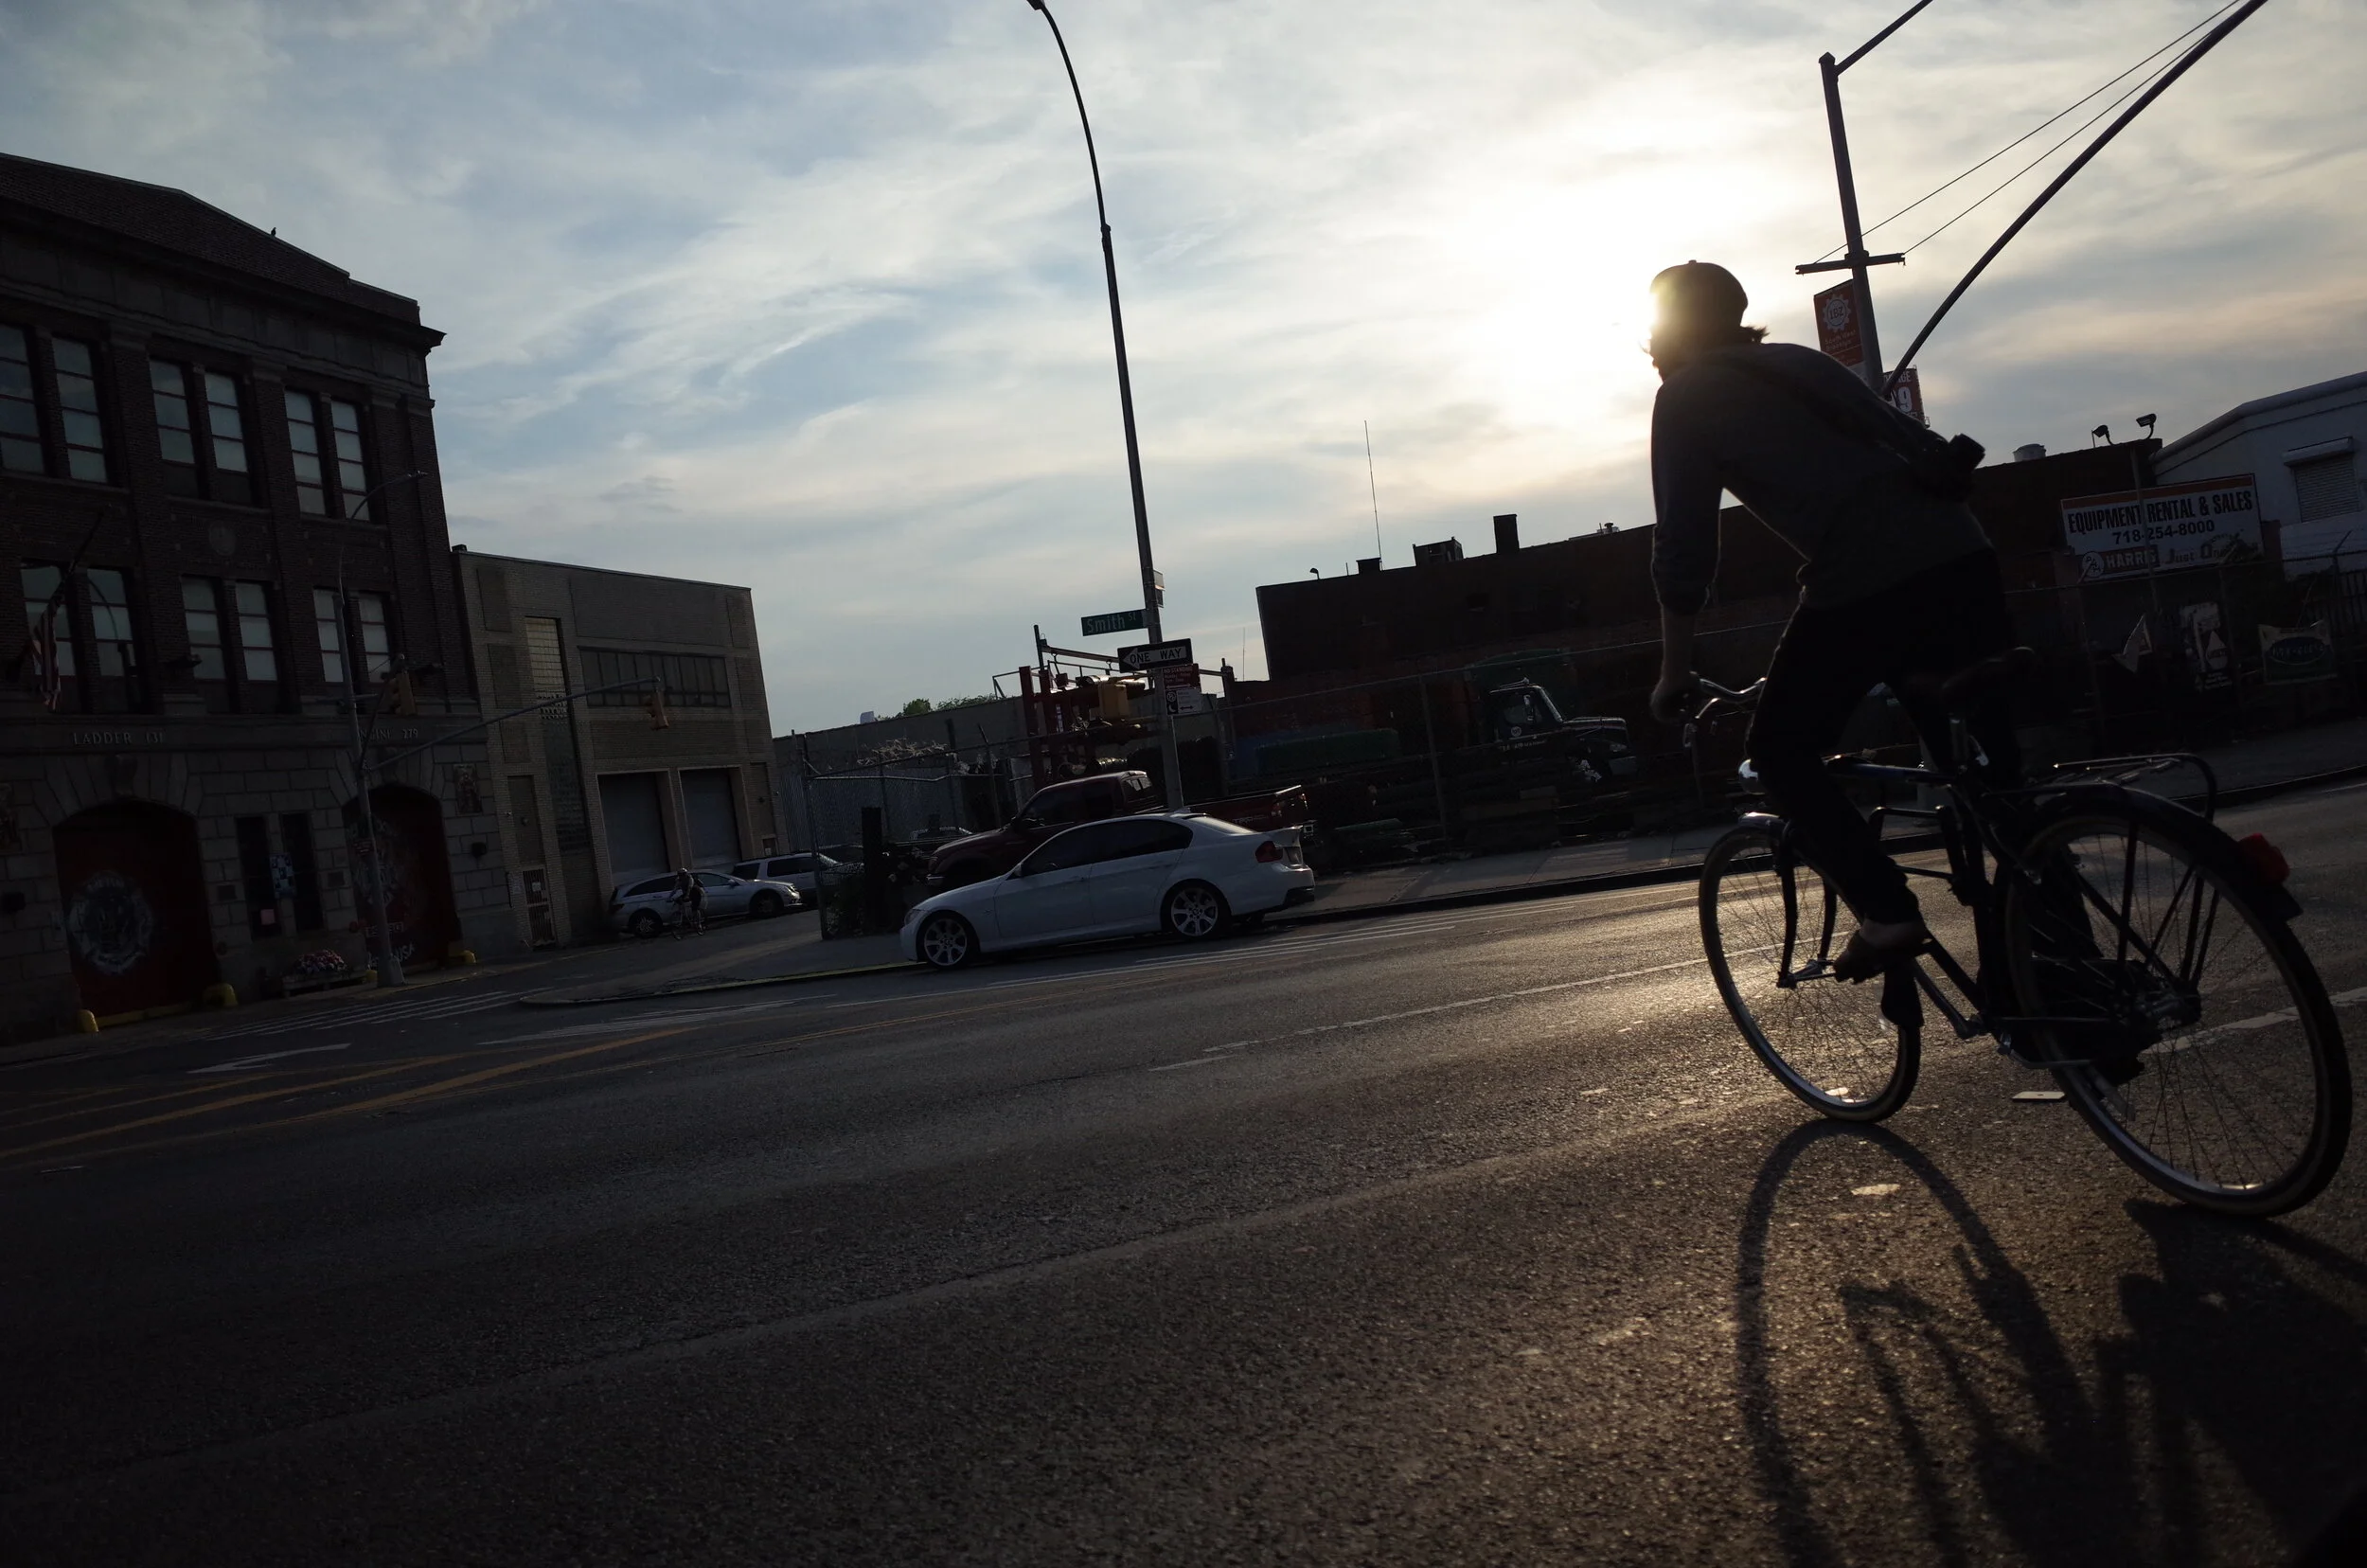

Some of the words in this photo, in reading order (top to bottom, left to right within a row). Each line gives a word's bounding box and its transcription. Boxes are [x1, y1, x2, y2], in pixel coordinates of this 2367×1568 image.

[1829, 306, 1844, 320] IBZ
[2067, 505, 2142, 535] EQUIPMENT
[2145, 497, 2196, 523] RENTAL
[2198, 494, 2209, 516] &
[2212, 490, 2253, 515] SALES
[2111, 520, 2216, 545] 718-254-8000
[1086, 615, 1126, 633] Smith
[1128, 612, 1136, 622] St
[1130, 652, 1151, 664] ONE
[1160, 648, 1182, 660] WAY
[73, 731, 133, 745] LADDER
